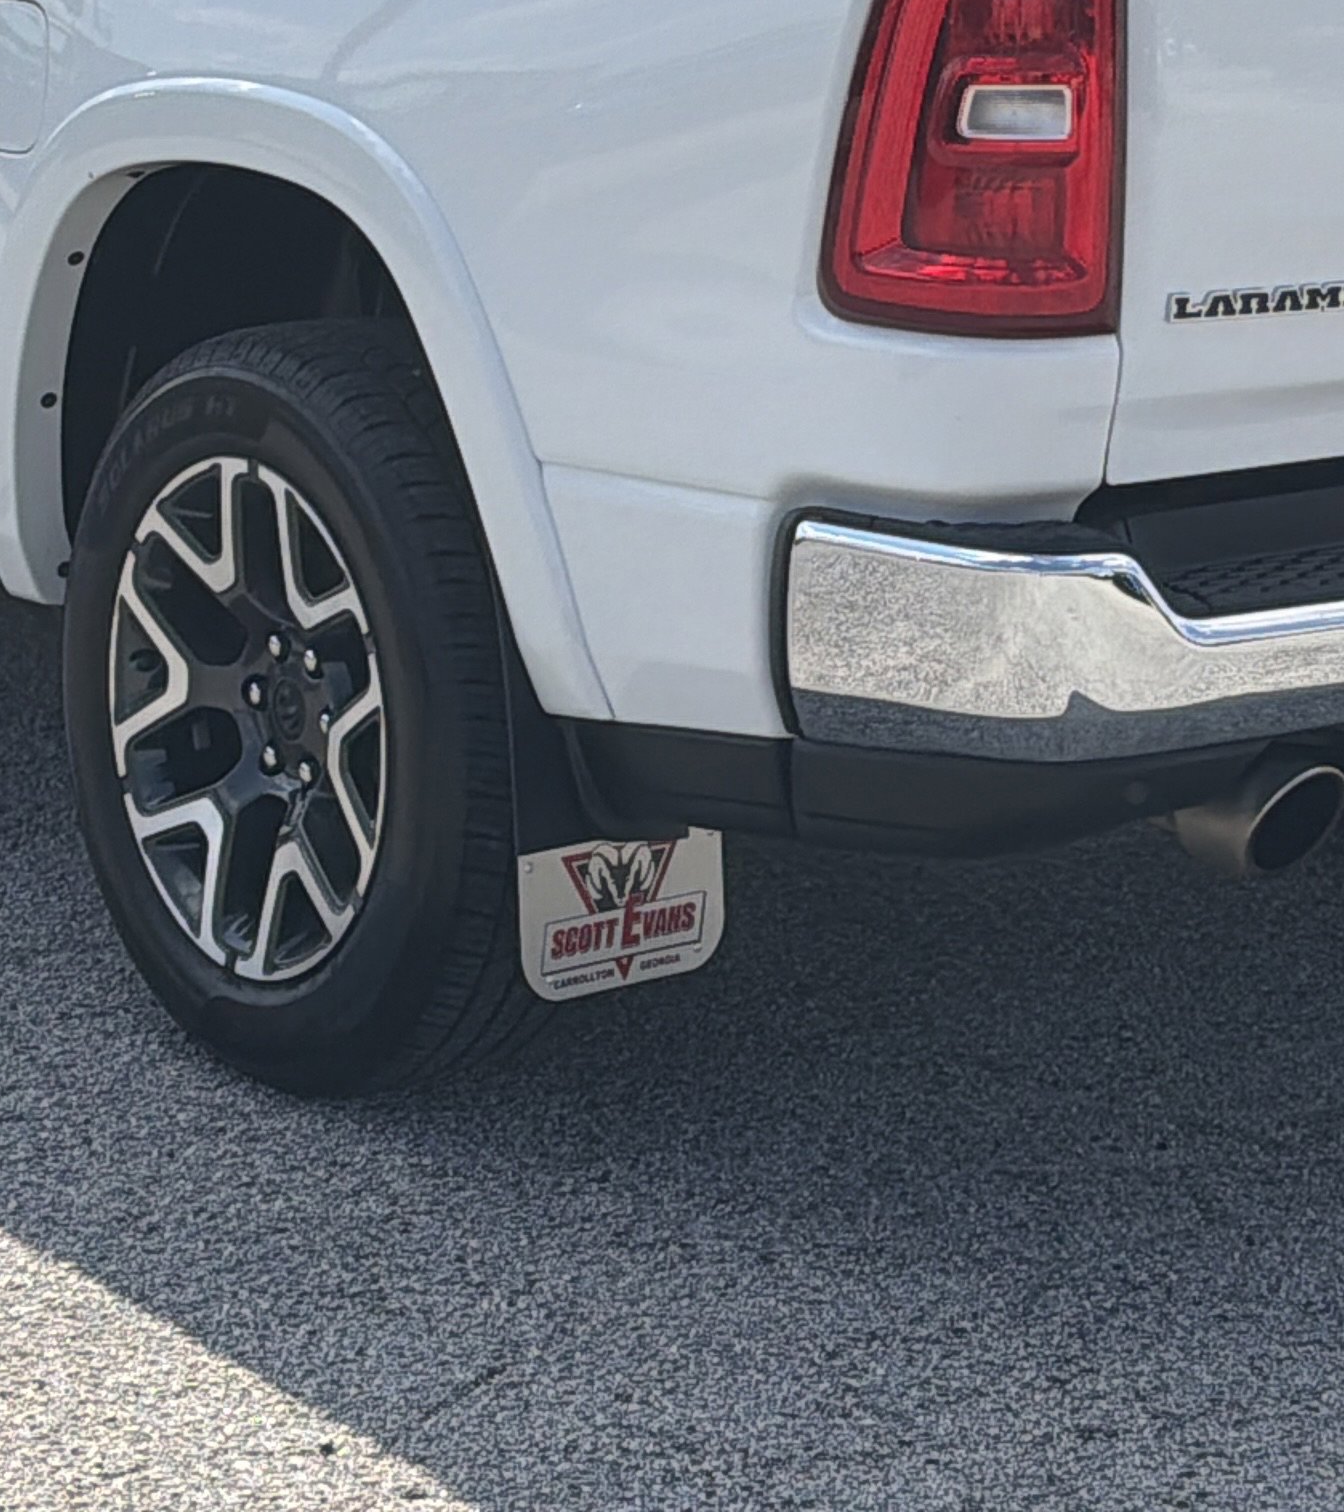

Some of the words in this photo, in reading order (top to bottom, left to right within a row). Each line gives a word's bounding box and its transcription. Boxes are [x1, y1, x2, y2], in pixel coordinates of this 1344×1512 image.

[550, 917, 620, 960] SCOTT
[620, 892, 697, 950] EVANS
[639, 953, 681, 971] GEORGIA
